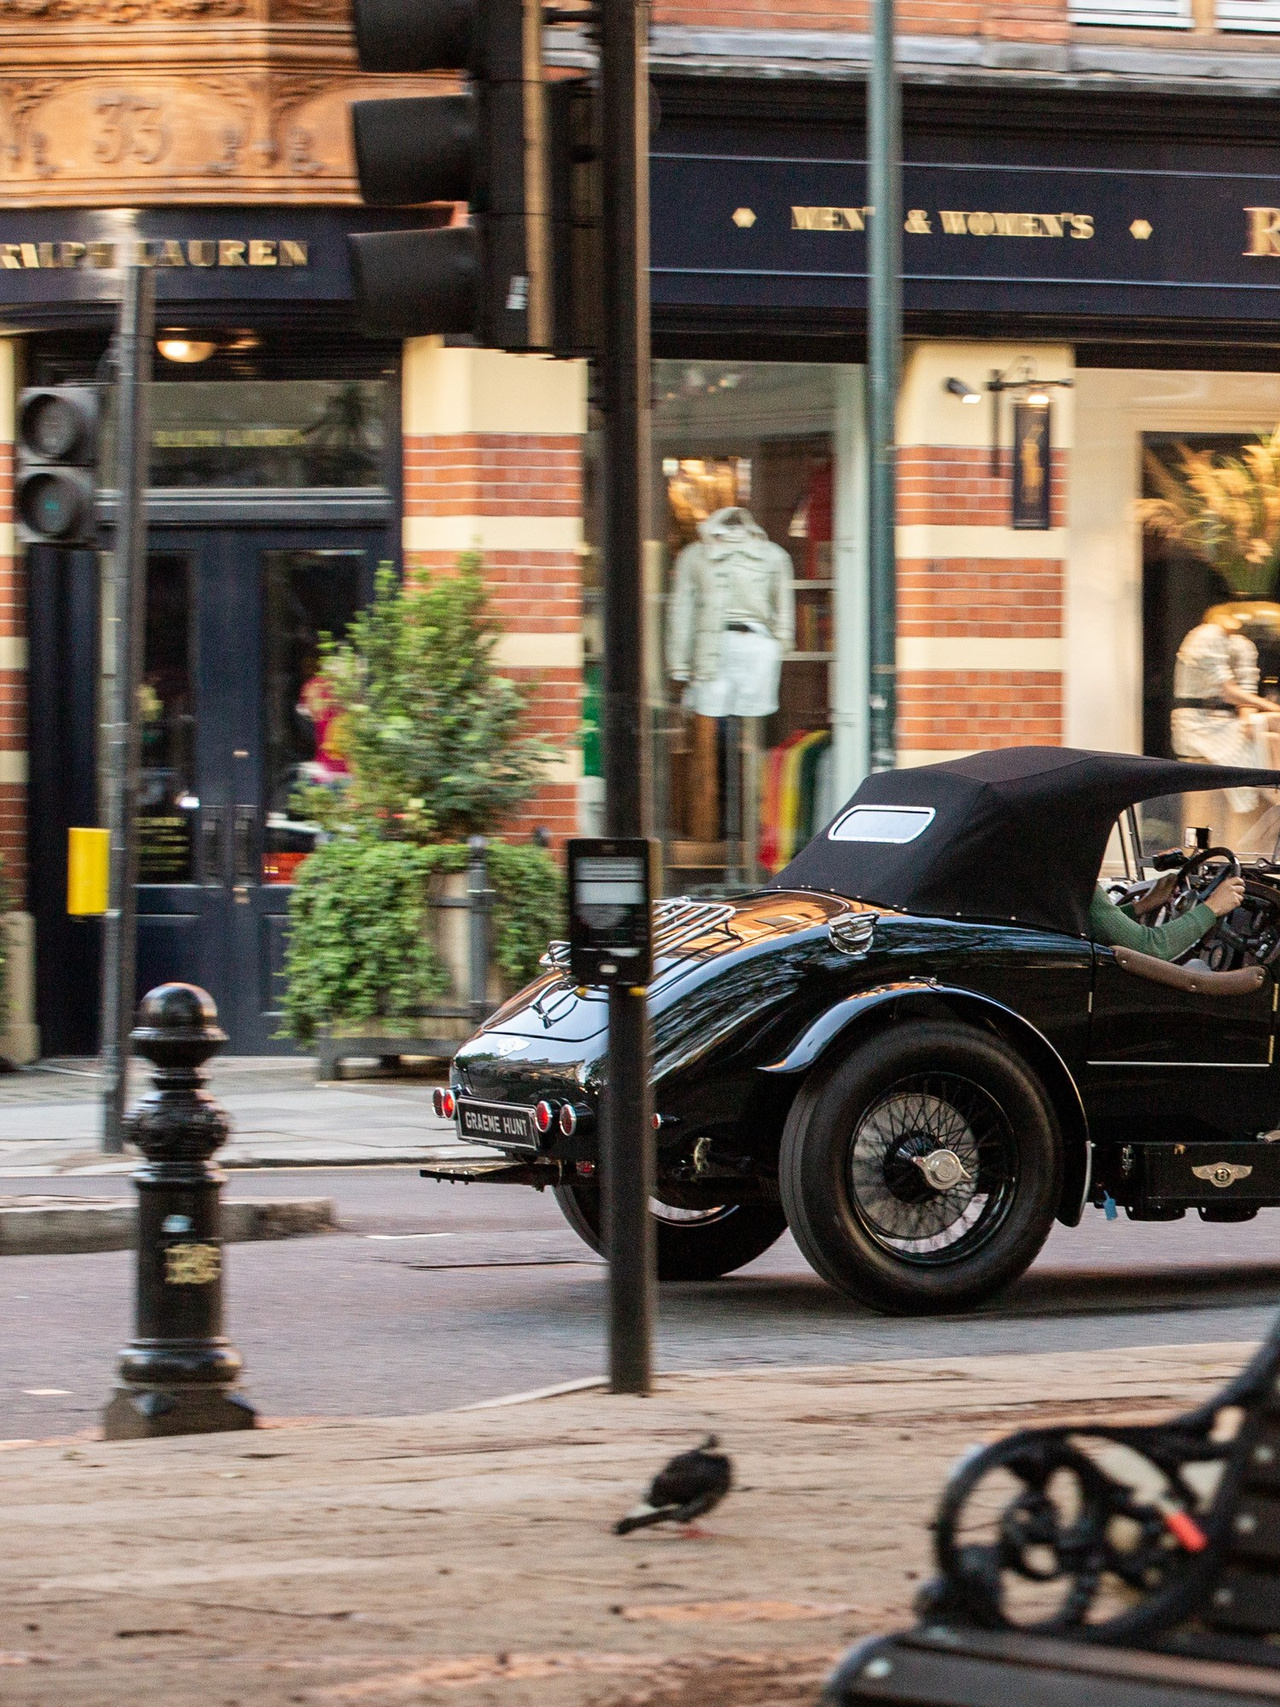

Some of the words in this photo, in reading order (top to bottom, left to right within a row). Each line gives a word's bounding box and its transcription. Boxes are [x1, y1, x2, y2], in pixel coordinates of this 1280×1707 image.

[904, 209, 932, 235] &
[938, 210, 1094, 240] WOMEN'S
[132, 239, 309, 267] LAUREN
[465, 1111, 501, 1133] GRAEME
[502, 1116, 527, 1136] HUNT
